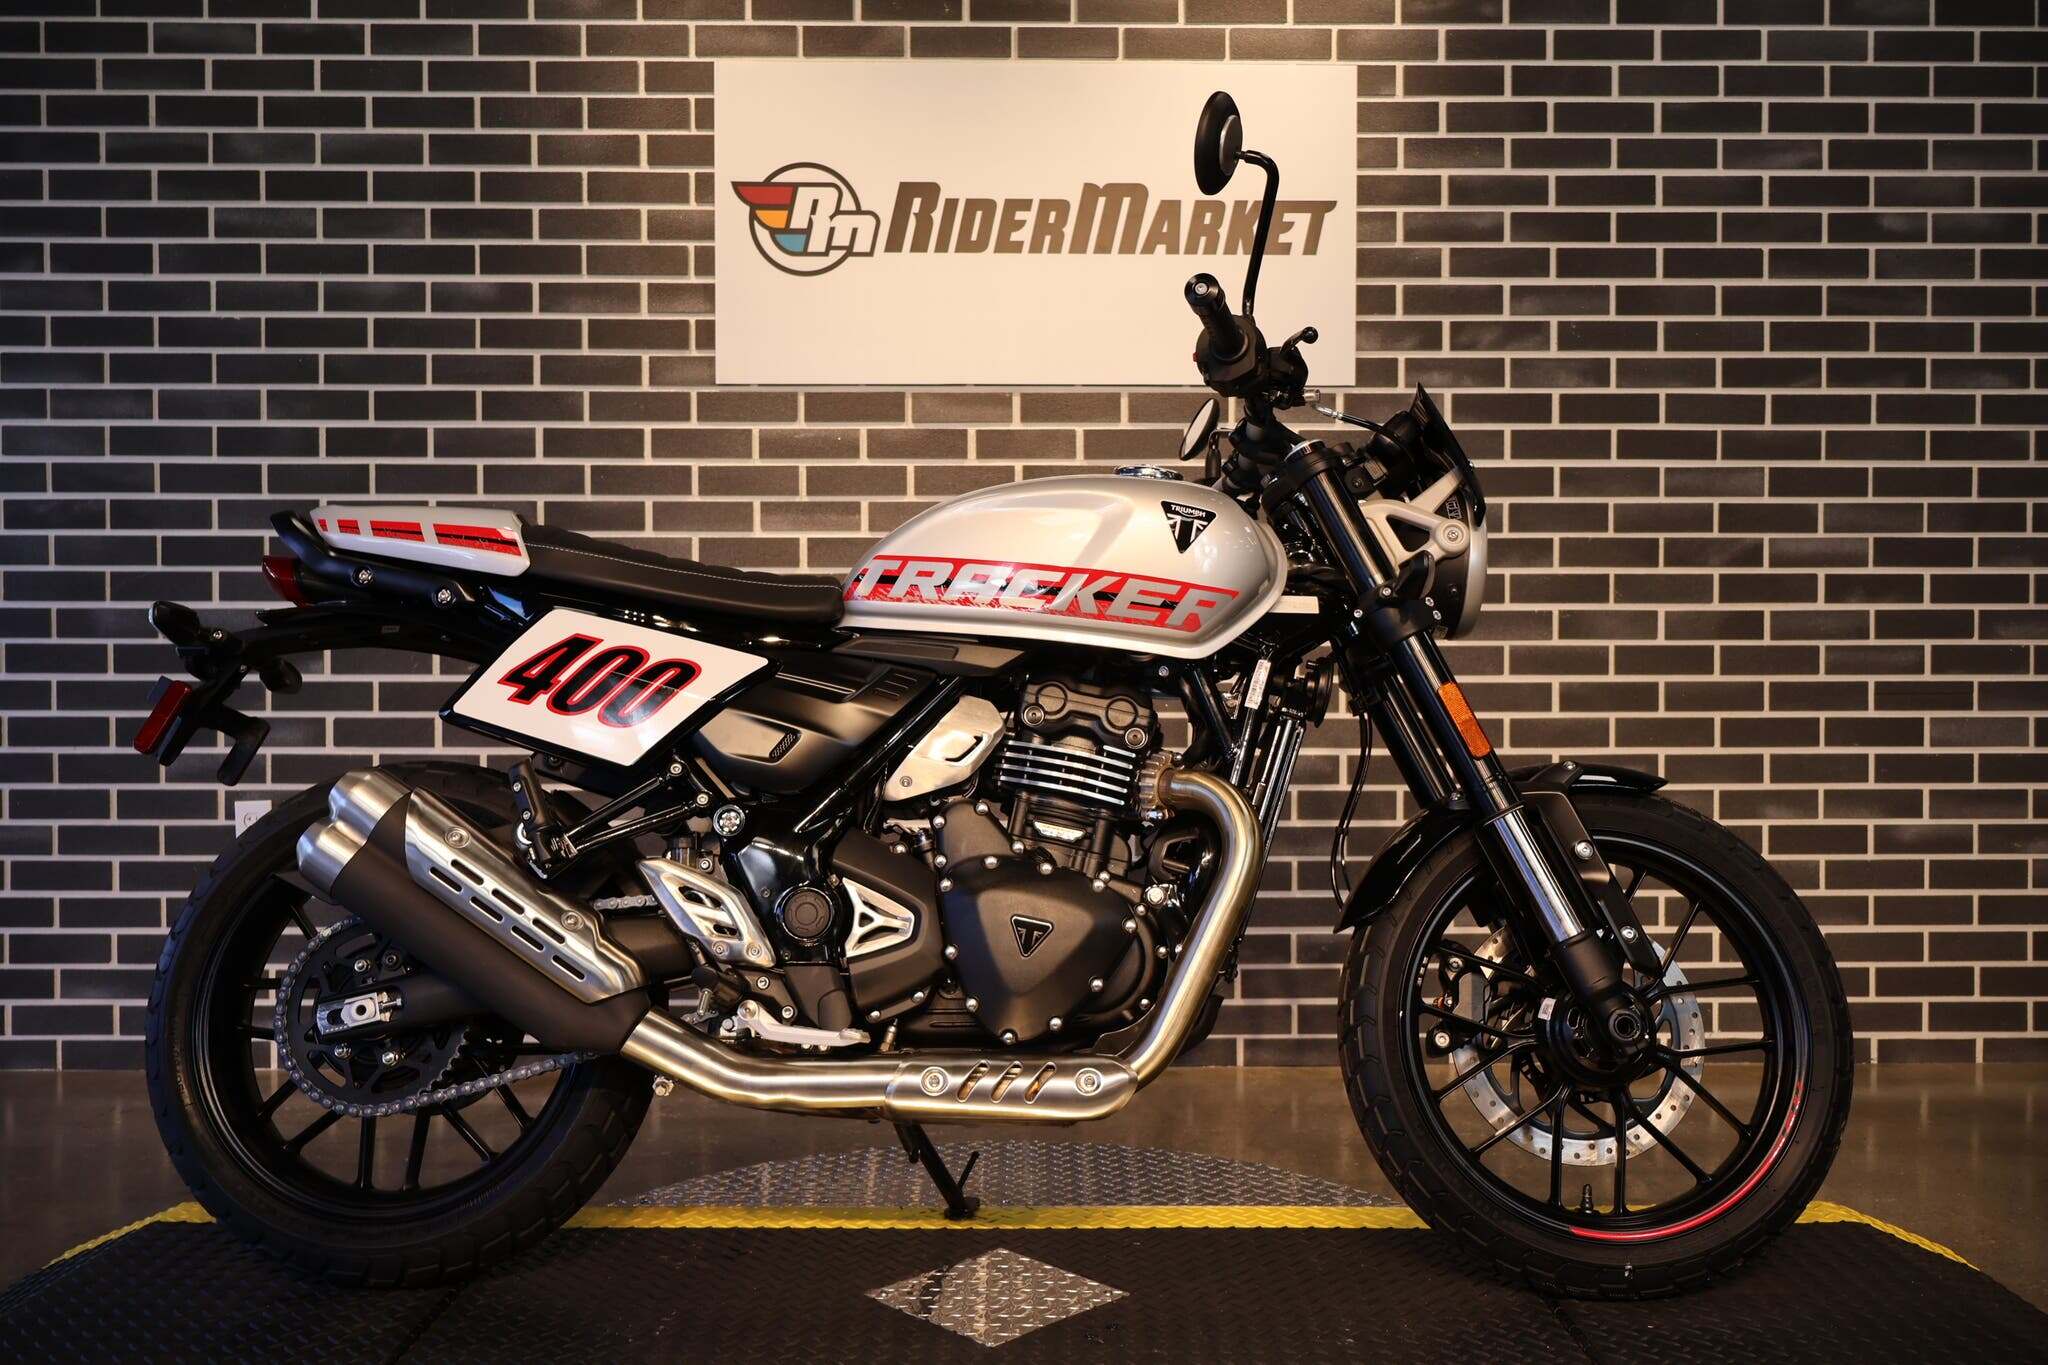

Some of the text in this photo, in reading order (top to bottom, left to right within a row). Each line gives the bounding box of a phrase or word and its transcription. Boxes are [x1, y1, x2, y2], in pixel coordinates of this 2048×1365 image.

[1170, 504, 1206, 518] TRIUMPH
[856, 559, 1235, 627] TRACKER
[497, 633, 702, 728] 400
